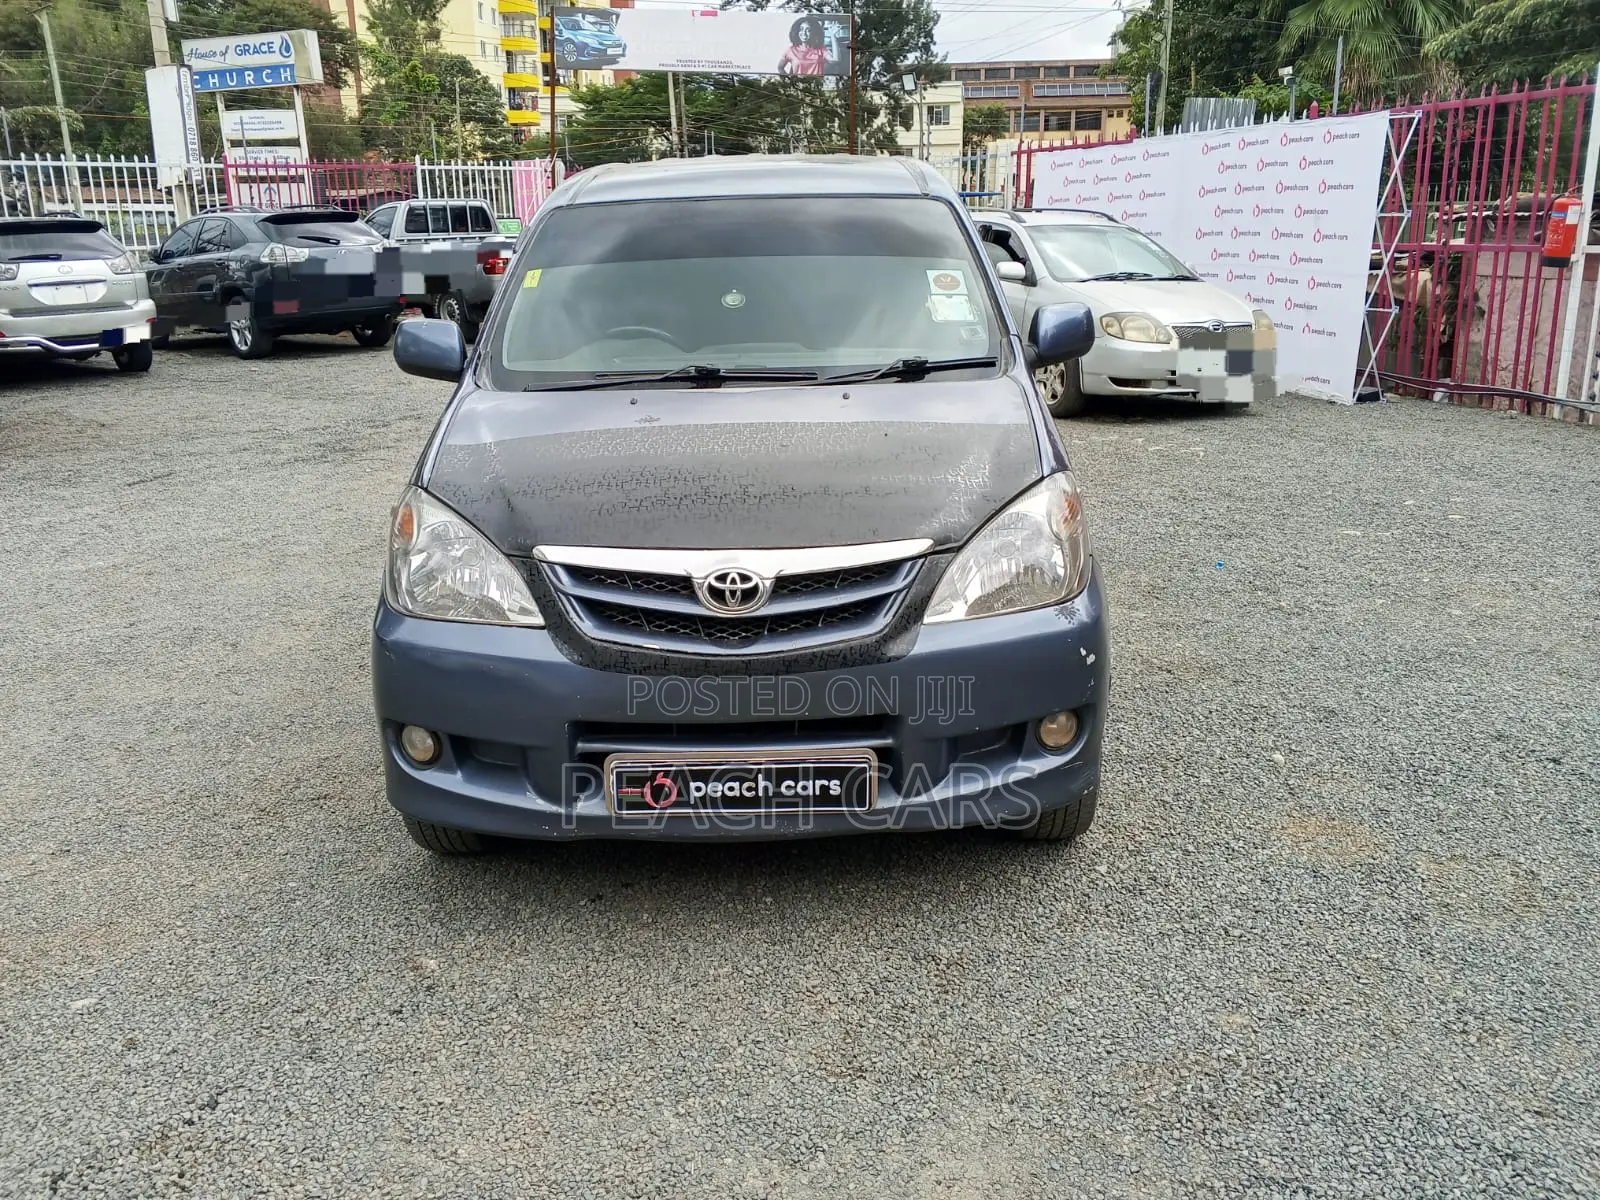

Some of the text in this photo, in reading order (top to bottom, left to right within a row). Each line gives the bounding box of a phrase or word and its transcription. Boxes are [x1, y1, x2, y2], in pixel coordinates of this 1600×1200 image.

[187, 42, 276, 62] House of GRACE
[193, 66, 292, 89] CHURCH
[188, 127, 197, 146] 0718
[690, 774, 842, 804] peach cars
